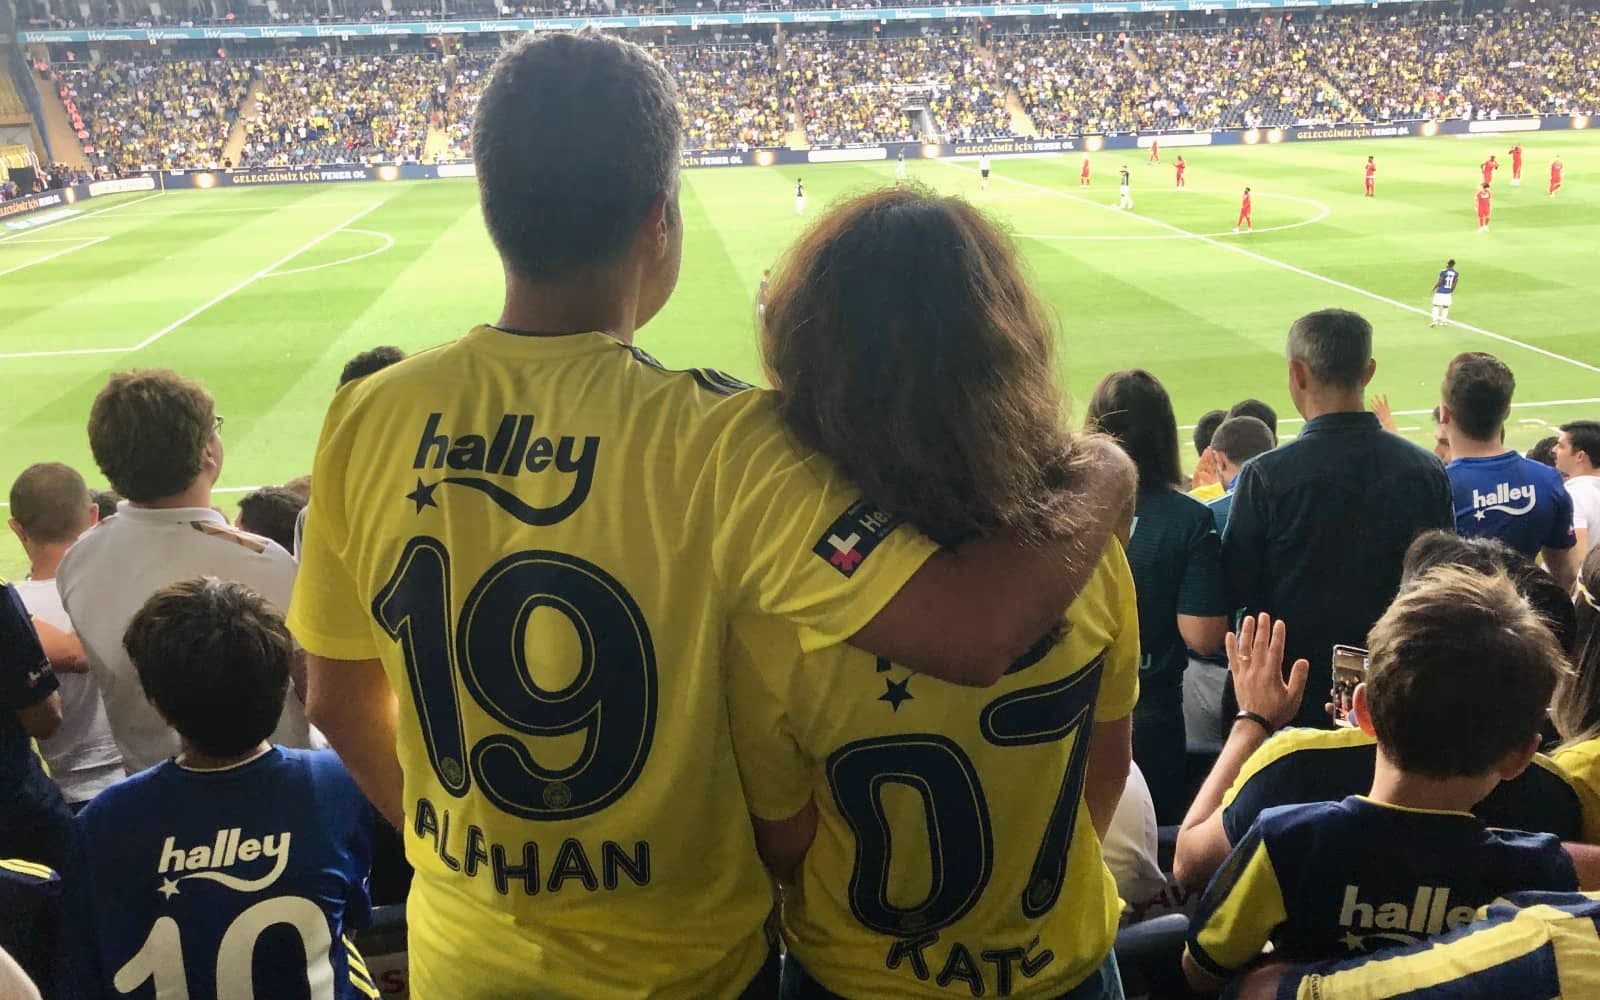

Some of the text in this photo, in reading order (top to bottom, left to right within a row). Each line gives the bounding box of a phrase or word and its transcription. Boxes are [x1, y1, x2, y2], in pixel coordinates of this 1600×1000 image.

[232, 171, 298, 184] GELECEĞİMİZ
[299, 171, 320, 182] İÇİN
[412, 412, 600, 526] halley
[1472, 482, 1536, 516] halley
[371, 535, 659, 822] 19
[825, 648, 1106, 939] 07
[158, 827, 291, 893] halley
[113, 895, 335, 1000] 10
[1338, 884, 1477, 936] halle
